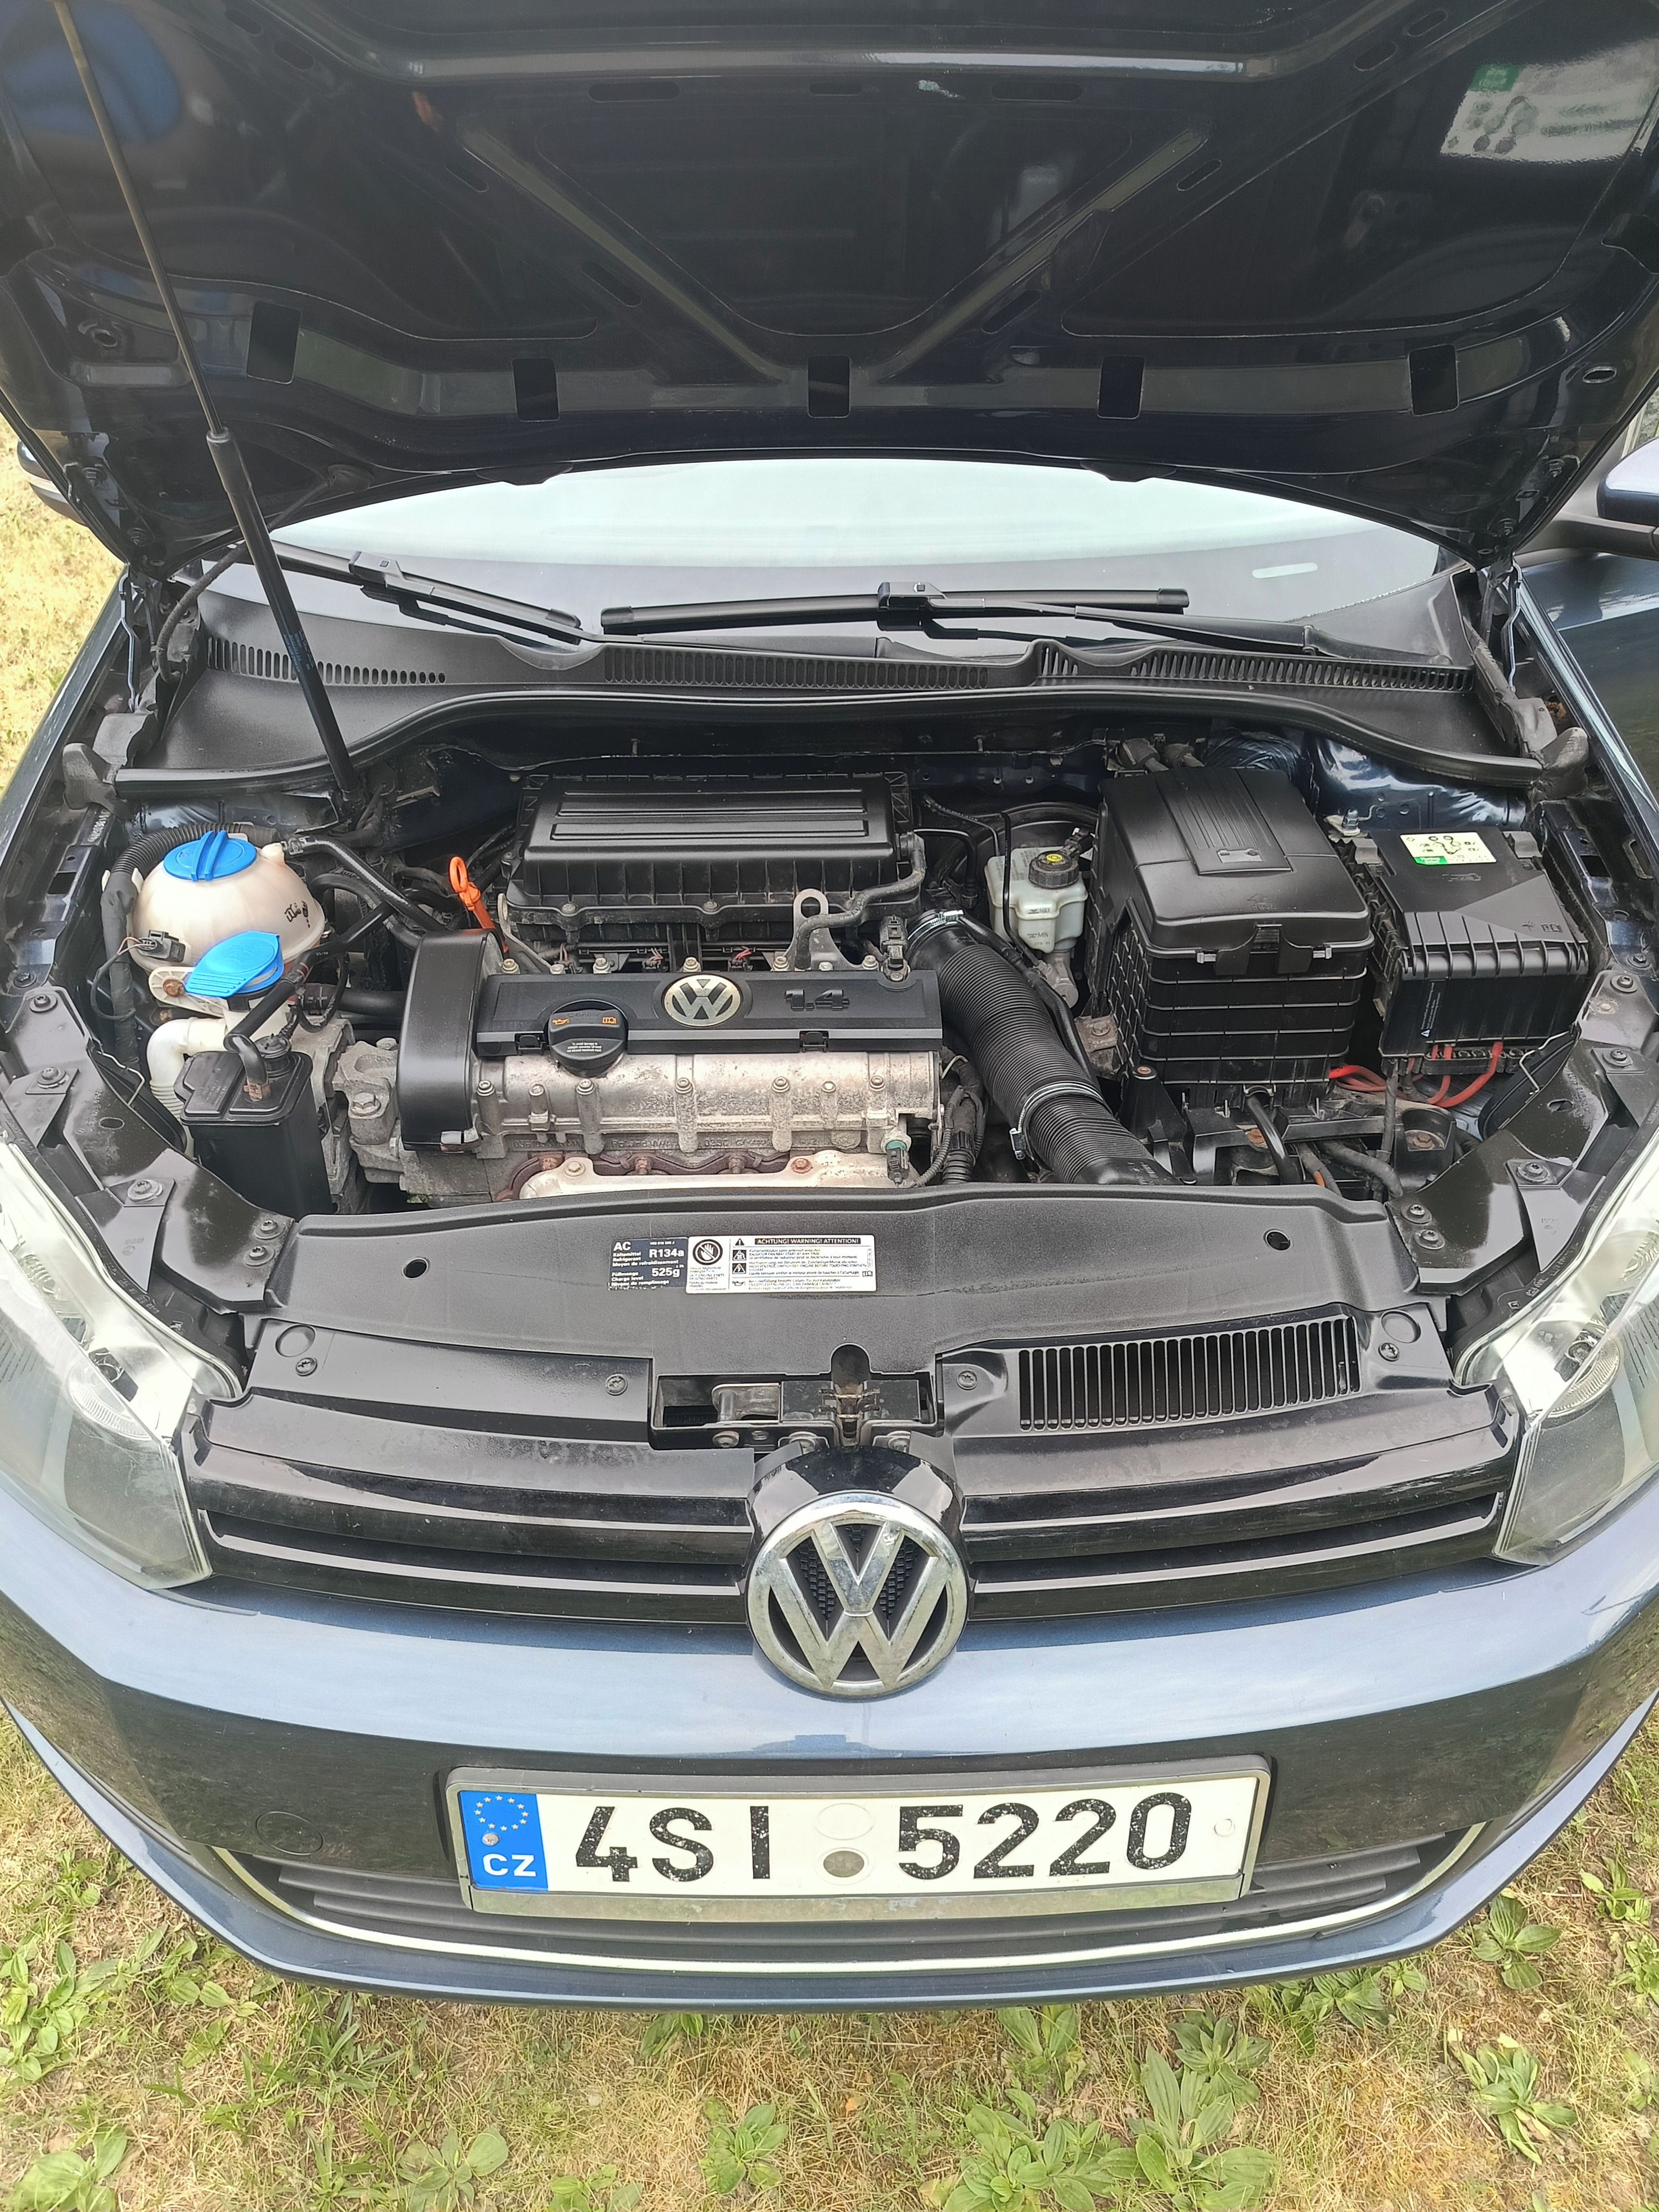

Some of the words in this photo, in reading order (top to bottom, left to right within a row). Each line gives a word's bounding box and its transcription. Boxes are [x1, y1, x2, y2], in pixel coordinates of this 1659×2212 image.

[785, 989, 850, 1009] 1.4
[613, 1241, 632, 1251] AC
[649, 1248, 684, 1258] R134a
[651, 1267, 680, 1277] 525g
[576, 1806, 770, 1882] 4SI
[898, 1792, 1192, 1880] 5220
[483, 1854, 536, 1877] CZ
